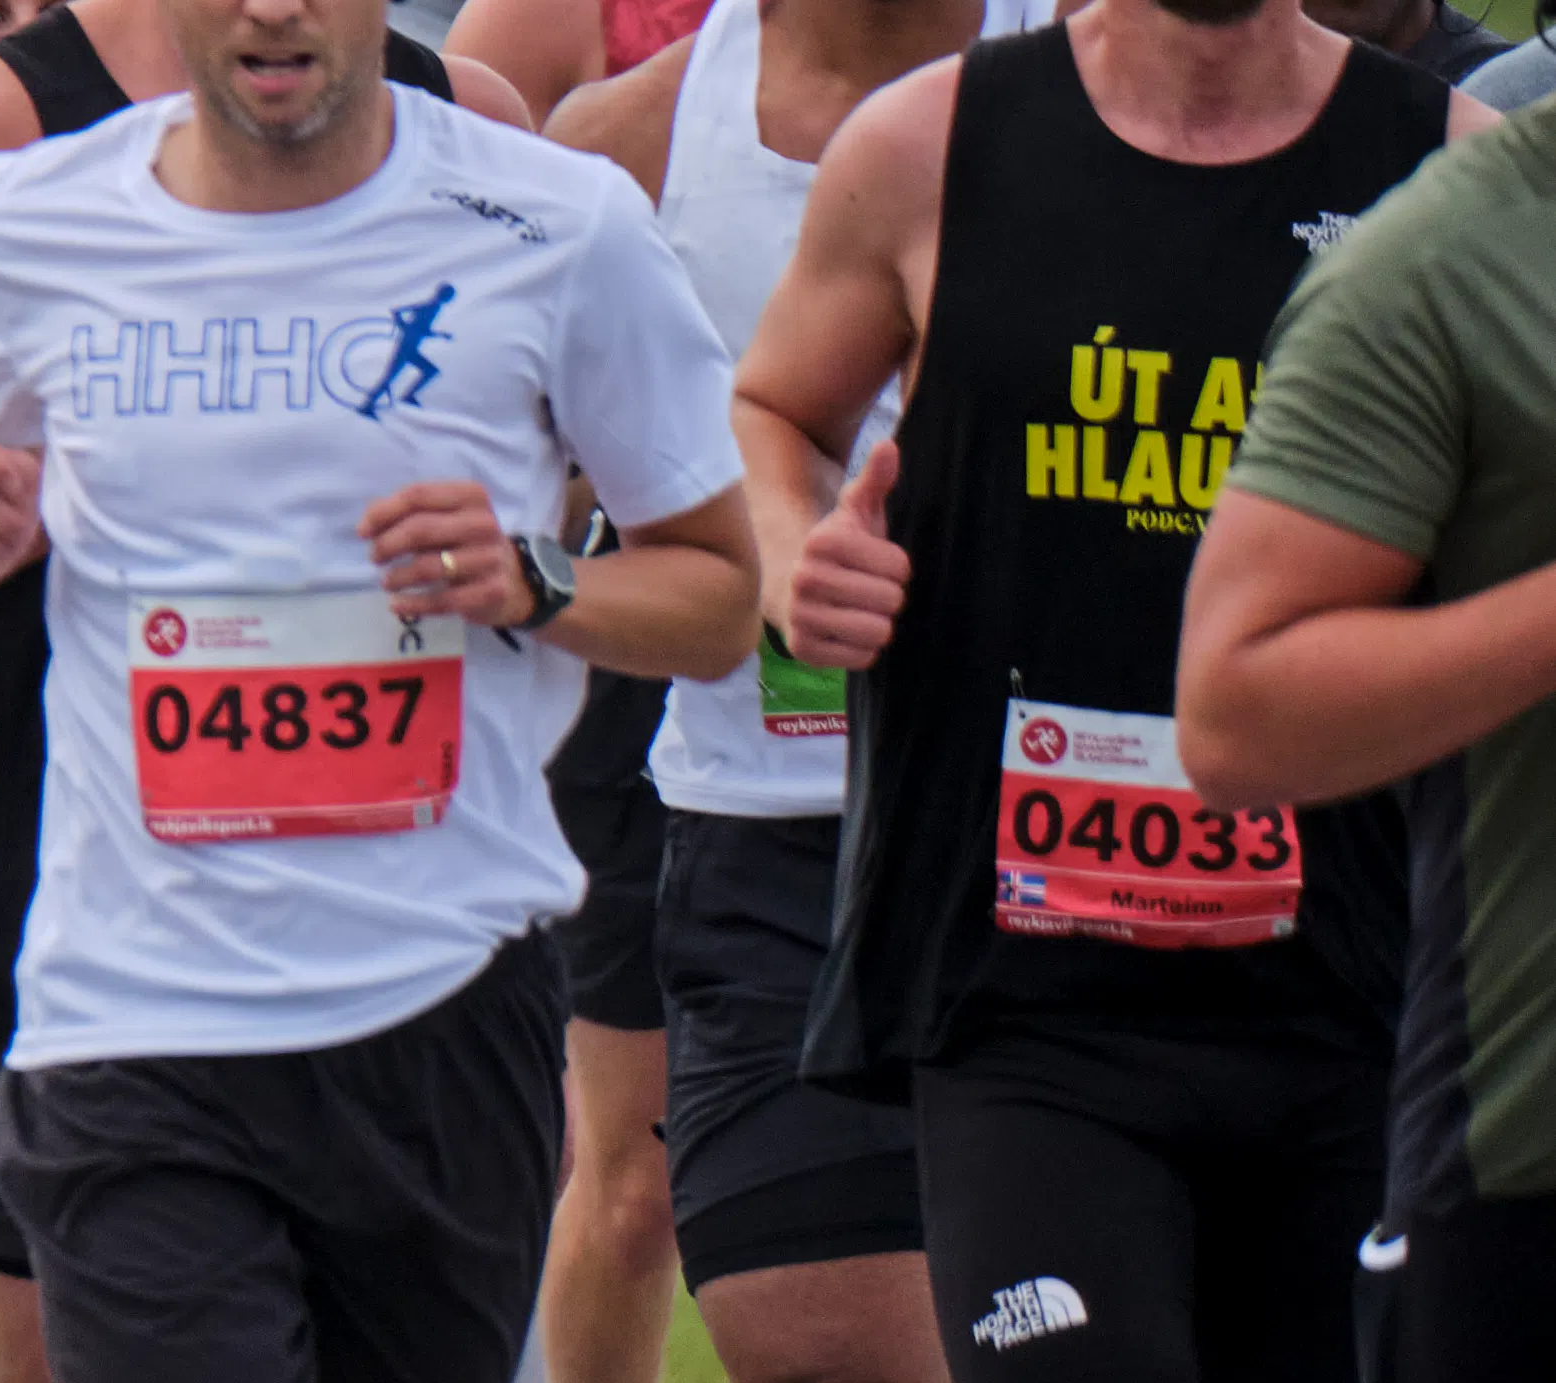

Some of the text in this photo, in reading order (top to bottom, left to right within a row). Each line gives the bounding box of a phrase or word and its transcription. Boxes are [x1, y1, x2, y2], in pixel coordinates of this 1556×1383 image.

[1070, 325, 1266, 432] ÚT A
[144, 674, 425, 754] 04837
[1013, 789, 1292, 872] 04033
[973, 1296, 1041, 1346] NORTH
[992, 1280, 1036, 1309] THE
[994, 1317, 1047, 1352] FACE
